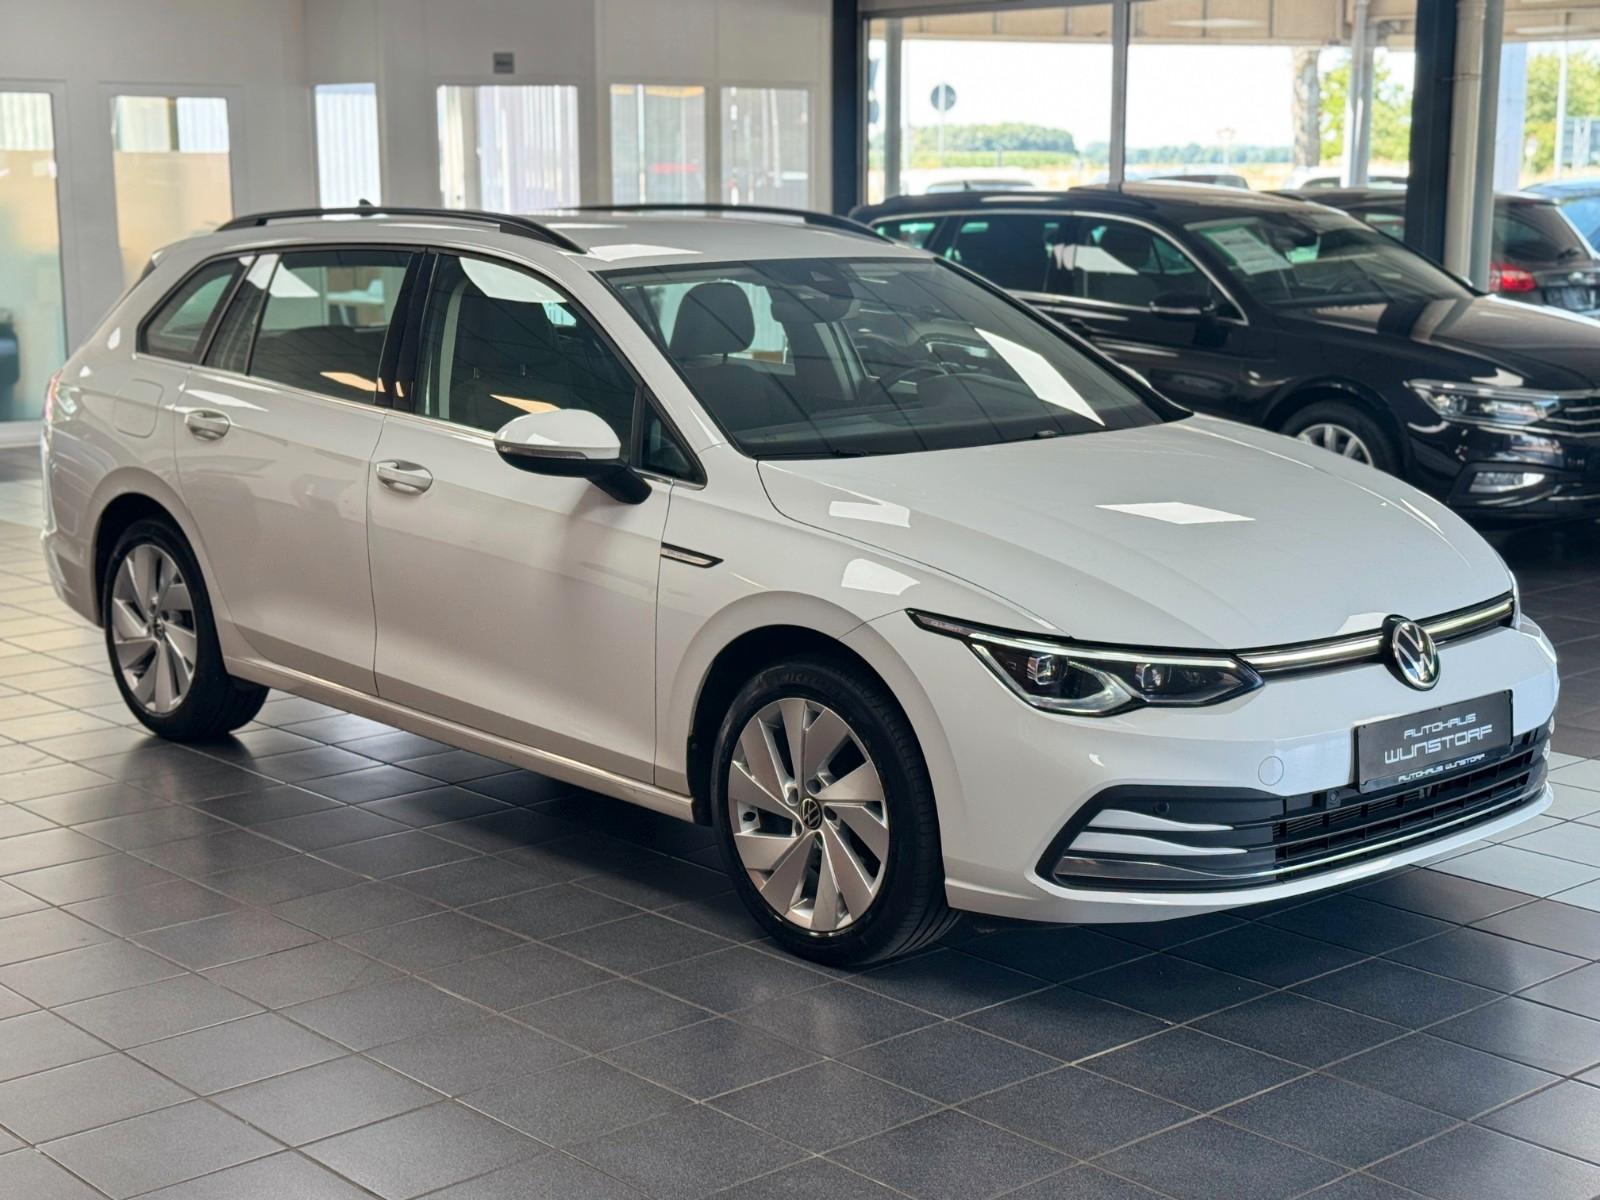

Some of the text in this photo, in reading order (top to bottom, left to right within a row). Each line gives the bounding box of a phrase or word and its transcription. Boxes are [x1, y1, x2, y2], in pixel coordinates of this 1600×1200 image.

[1403, 713, 1477, 740] AUTOHAUS
[1384, 724, 1493, 764] WUNSTORF
[1398, 753, 1485, 782] AUTOHAUS WUNSTORF
